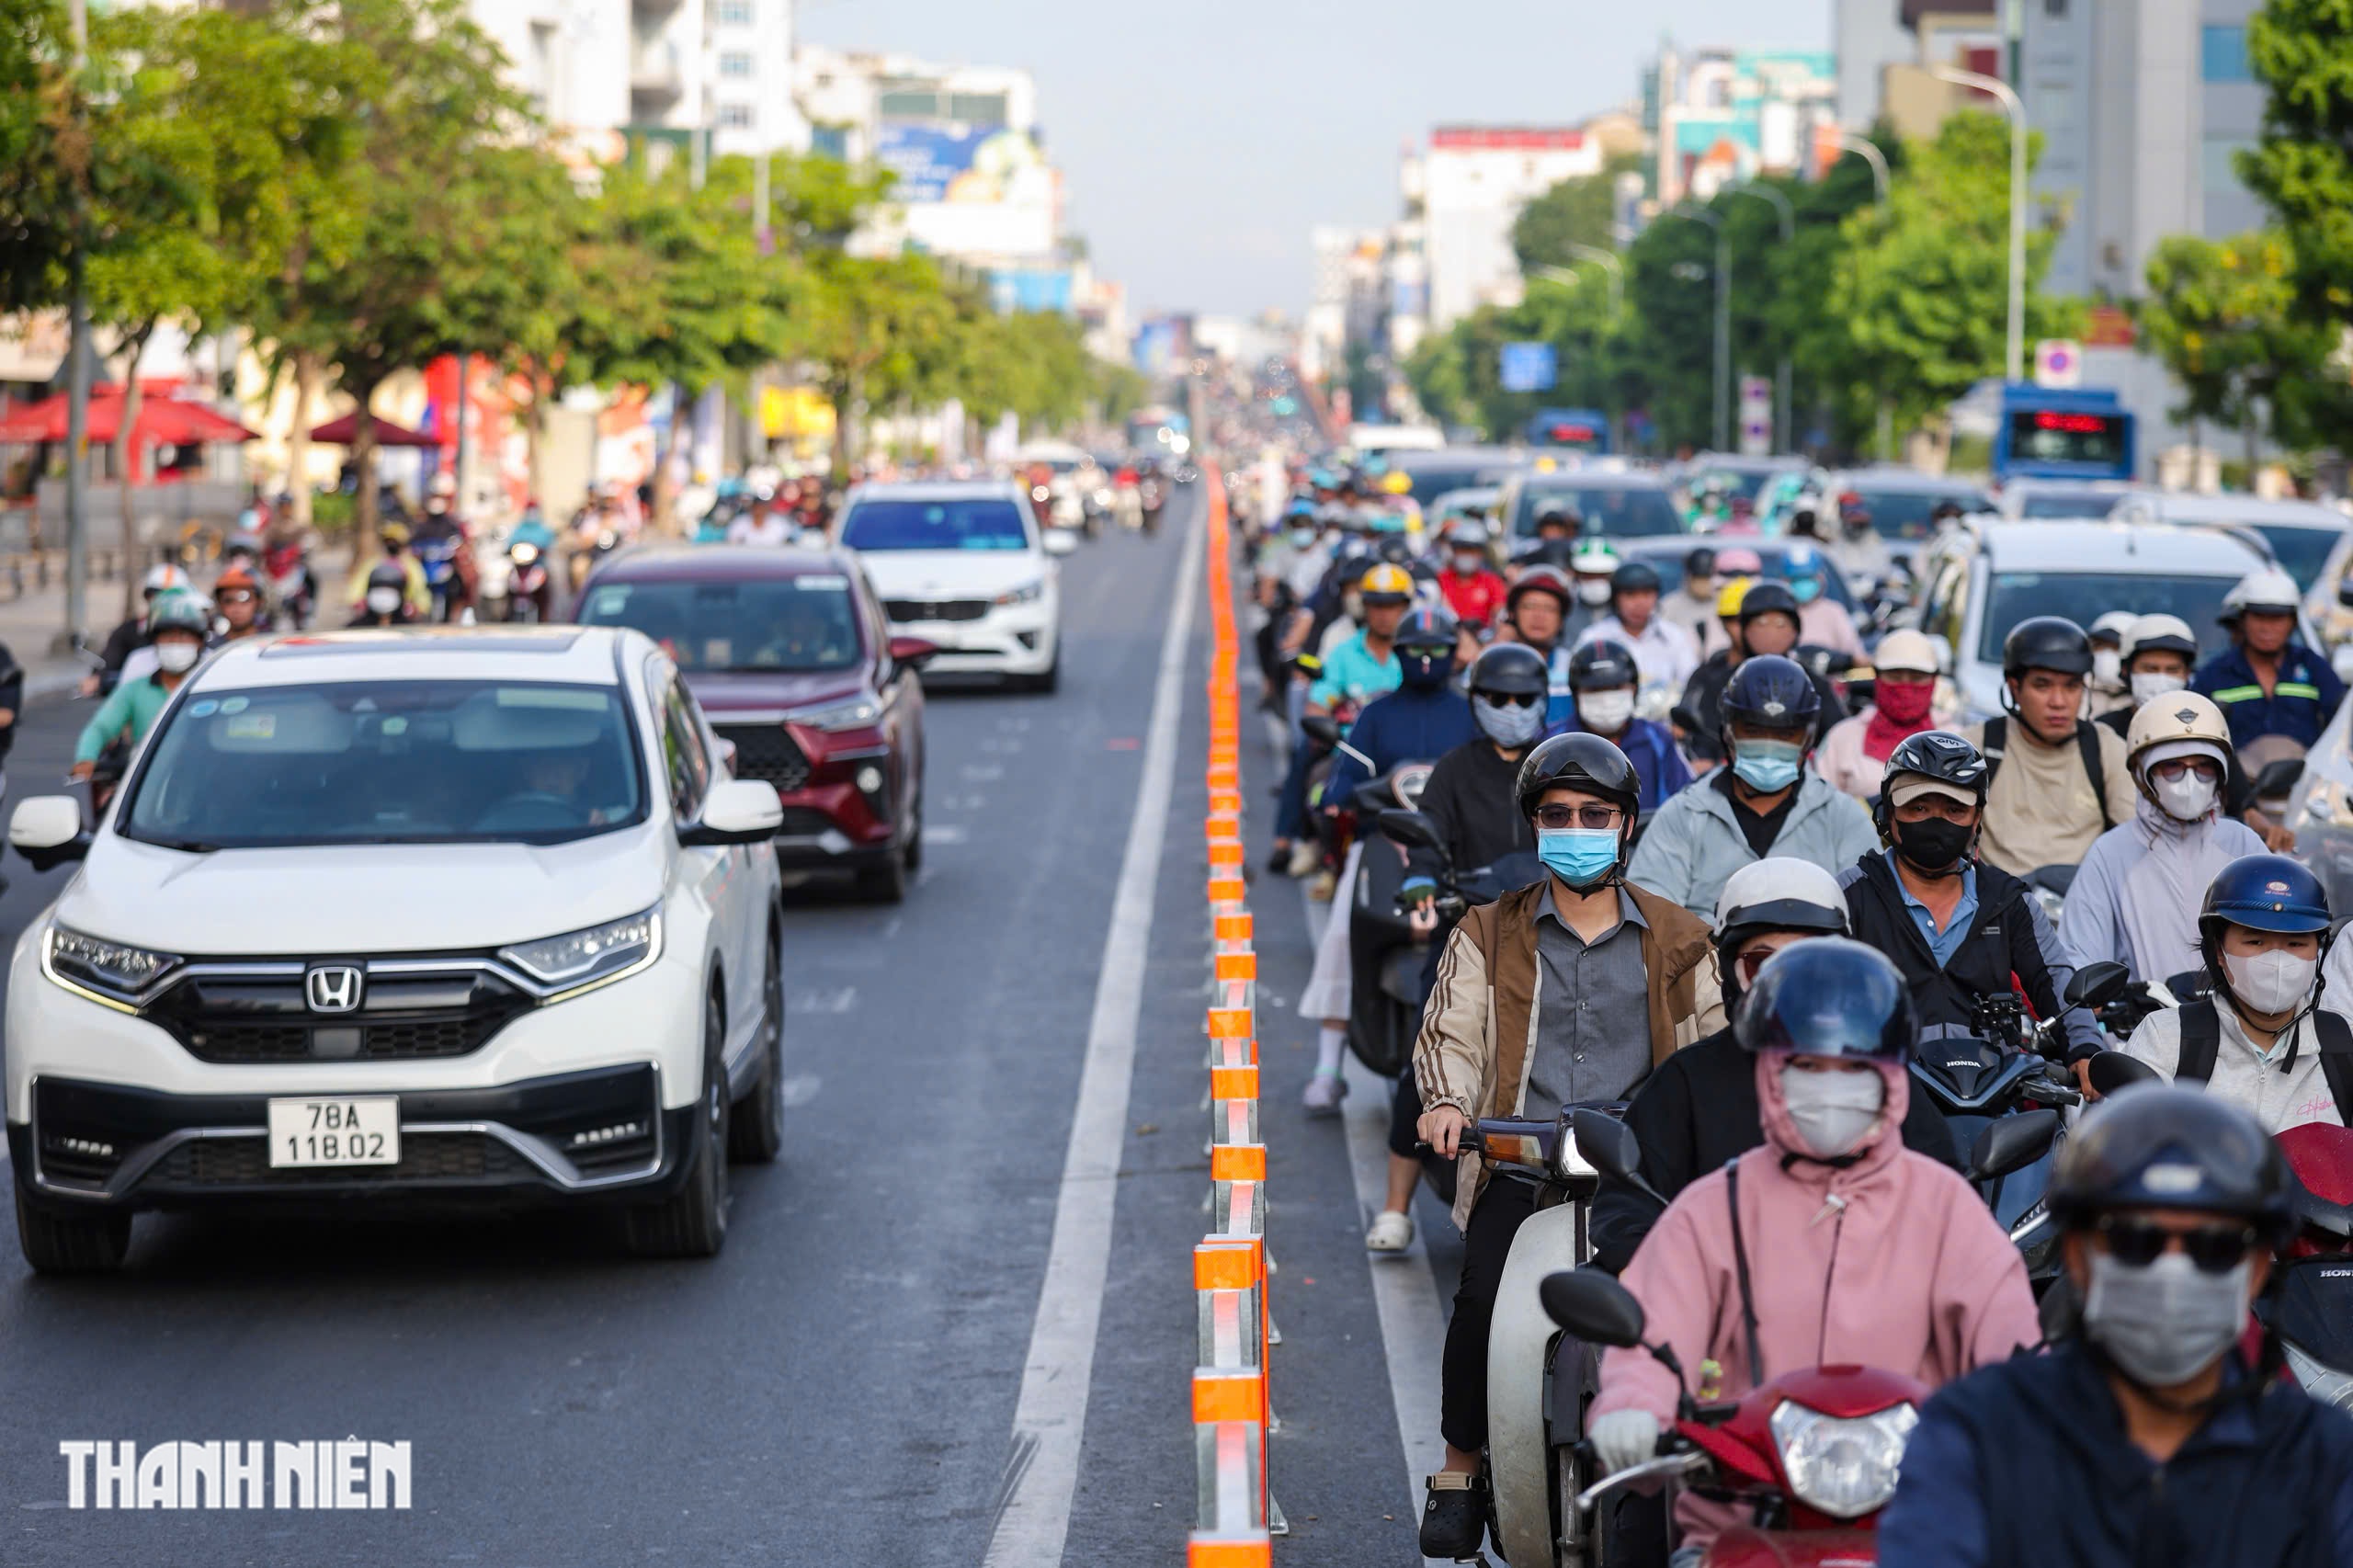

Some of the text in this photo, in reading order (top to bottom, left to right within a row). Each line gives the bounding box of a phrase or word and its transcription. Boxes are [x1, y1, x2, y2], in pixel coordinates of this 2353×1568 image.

[1936, 738, 1960, 746] GIVI
[307, 1104, 359, 1130] 78A
[289, 1133, 384, 1161] 118.02
[2320, 1269, 2353, 1278] HON
